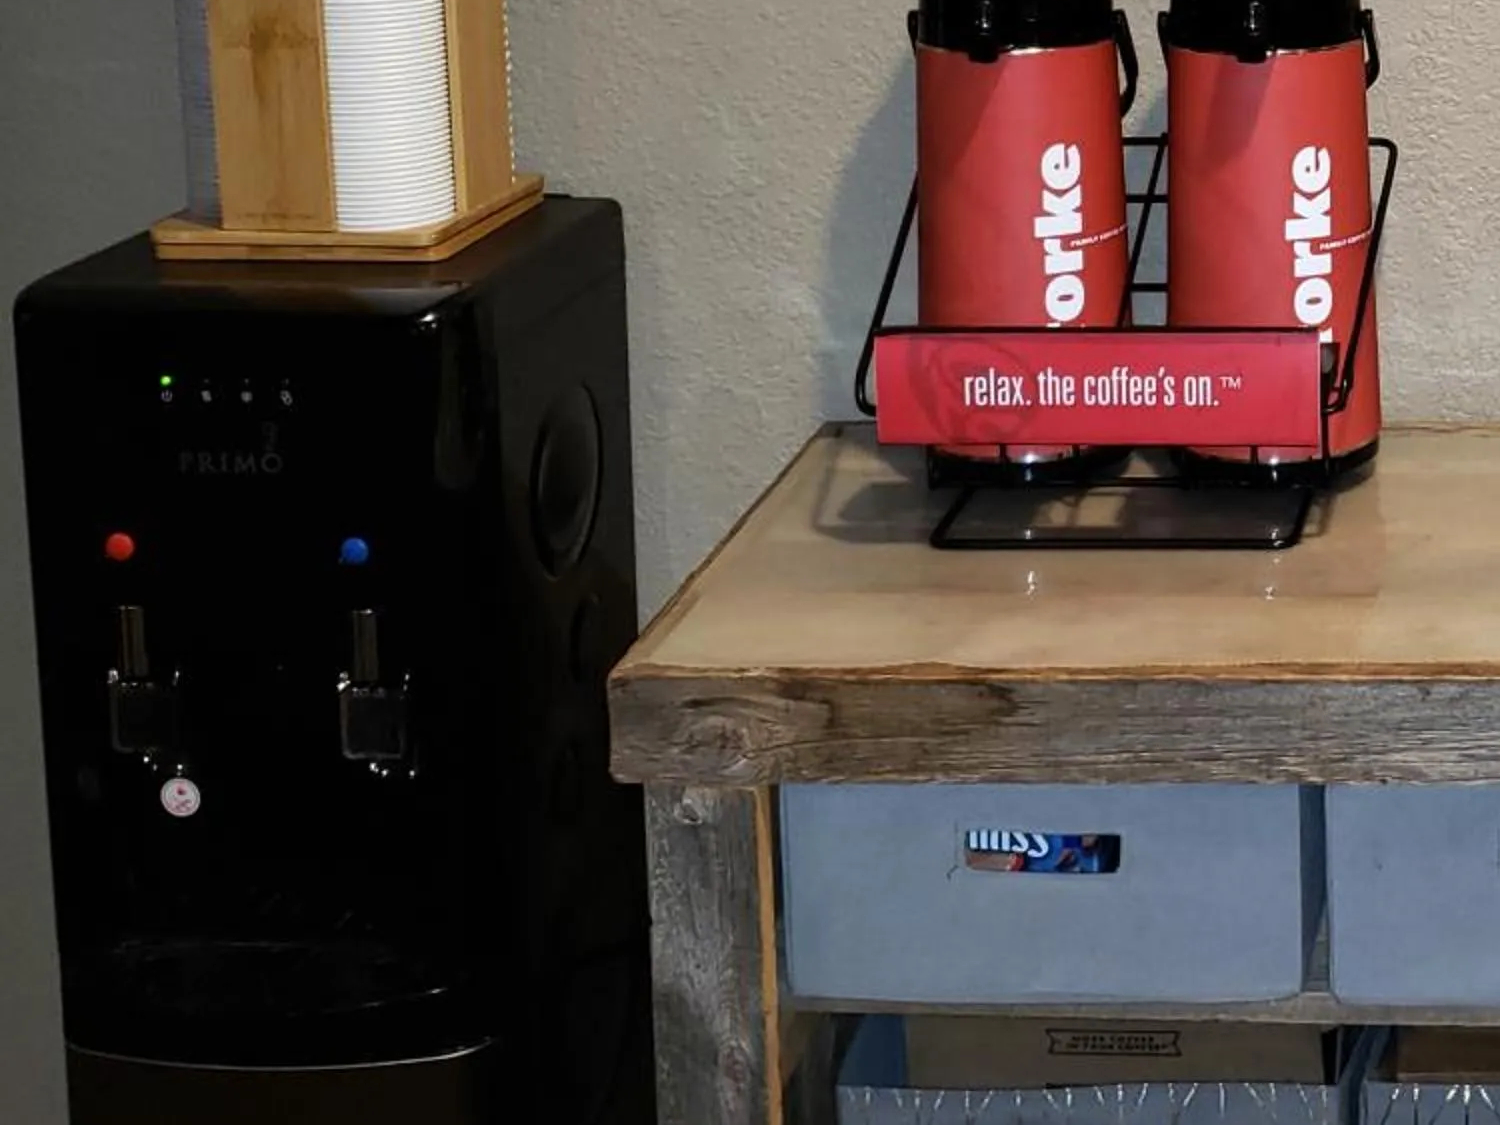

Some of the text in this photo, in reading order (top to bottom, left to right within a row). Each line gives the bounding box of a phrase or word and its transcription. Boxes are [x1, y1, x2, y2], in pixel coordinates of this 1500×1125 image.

[1034, 143, 1085, 326] orke
[1285, 145, 1333, 342] orke
[964, 367, 1031, 407] relax.
[1038, 366, 1075, 407] the
[1083, 366, 1175, 407] coffee's
[178, 451, 284, 474] PRIMO
